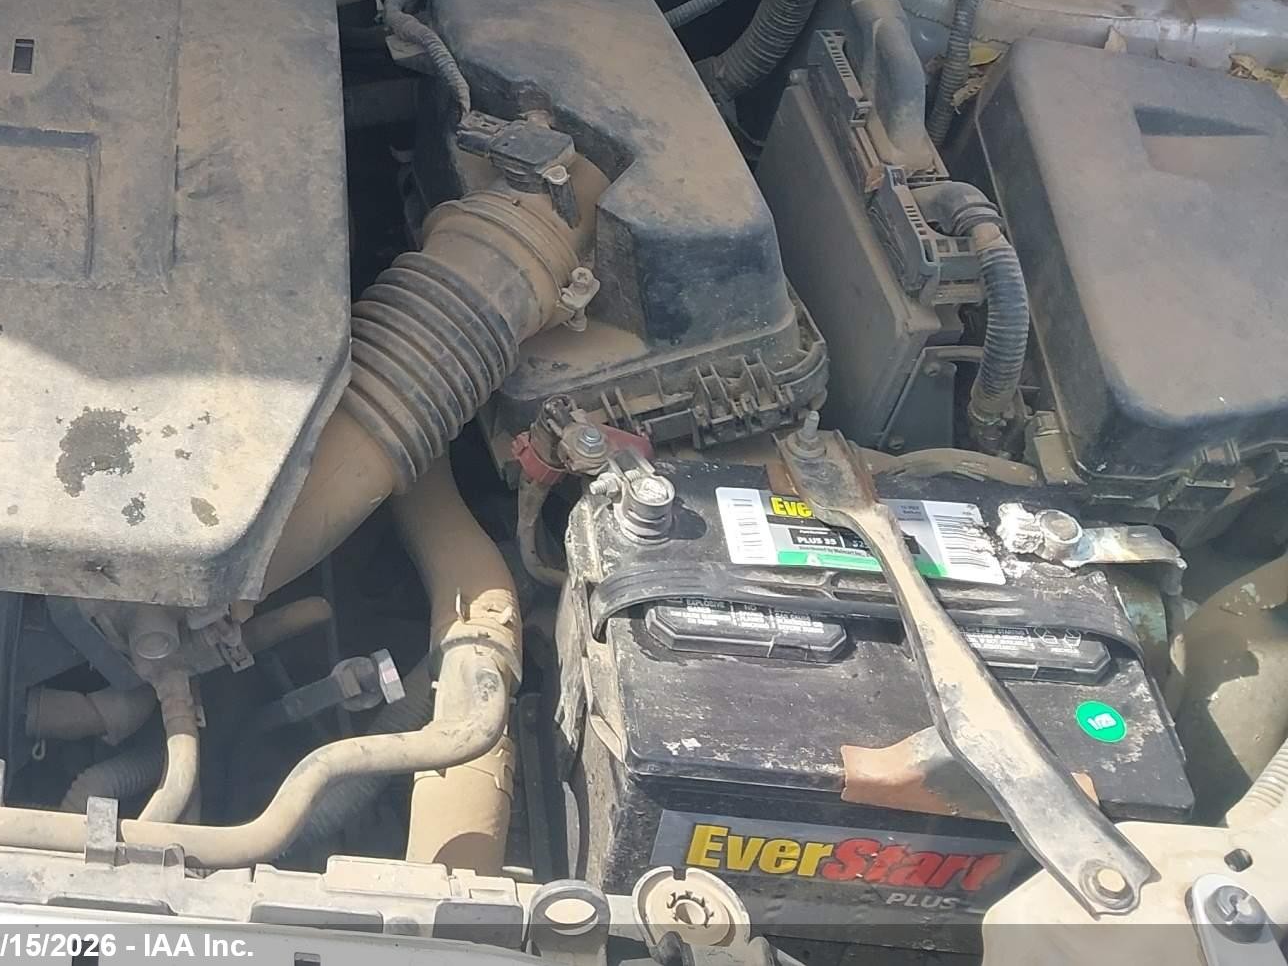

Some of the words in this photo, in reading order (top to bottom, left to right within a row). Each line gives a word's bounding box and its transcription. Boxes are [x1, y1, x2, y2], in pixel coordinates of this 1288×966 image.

[770, 496, 814, 518] Eve
[796, 535, 823, 545] PLUS
[685, 822, 1006, 892] EverStart
[885, 891, 959, 910] PLUS
